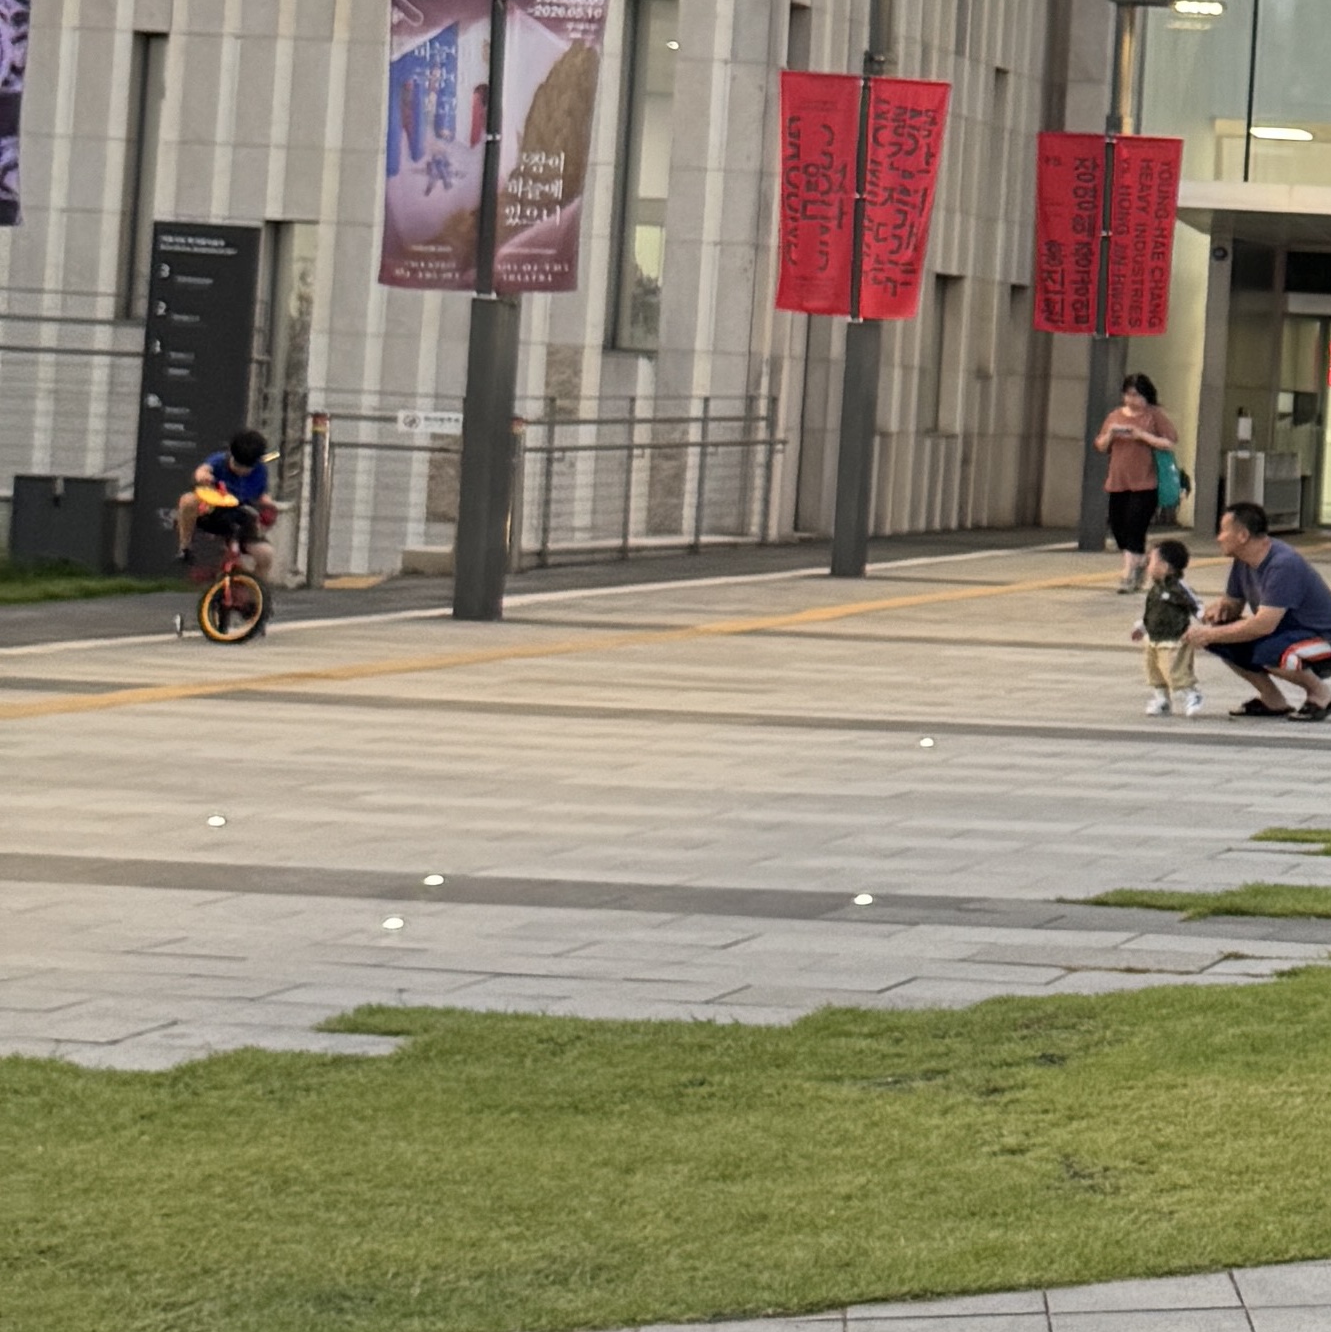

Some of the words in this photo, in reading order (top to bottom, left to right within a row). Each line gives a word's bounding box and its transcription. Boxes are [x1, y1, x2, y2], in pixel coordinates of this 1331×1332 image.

[1136, 158, 1153, 215] HEAVY
[1128, 222, 1147, 329] INDUSTRIES
[1148, 266, 1165, 329] CHANG
